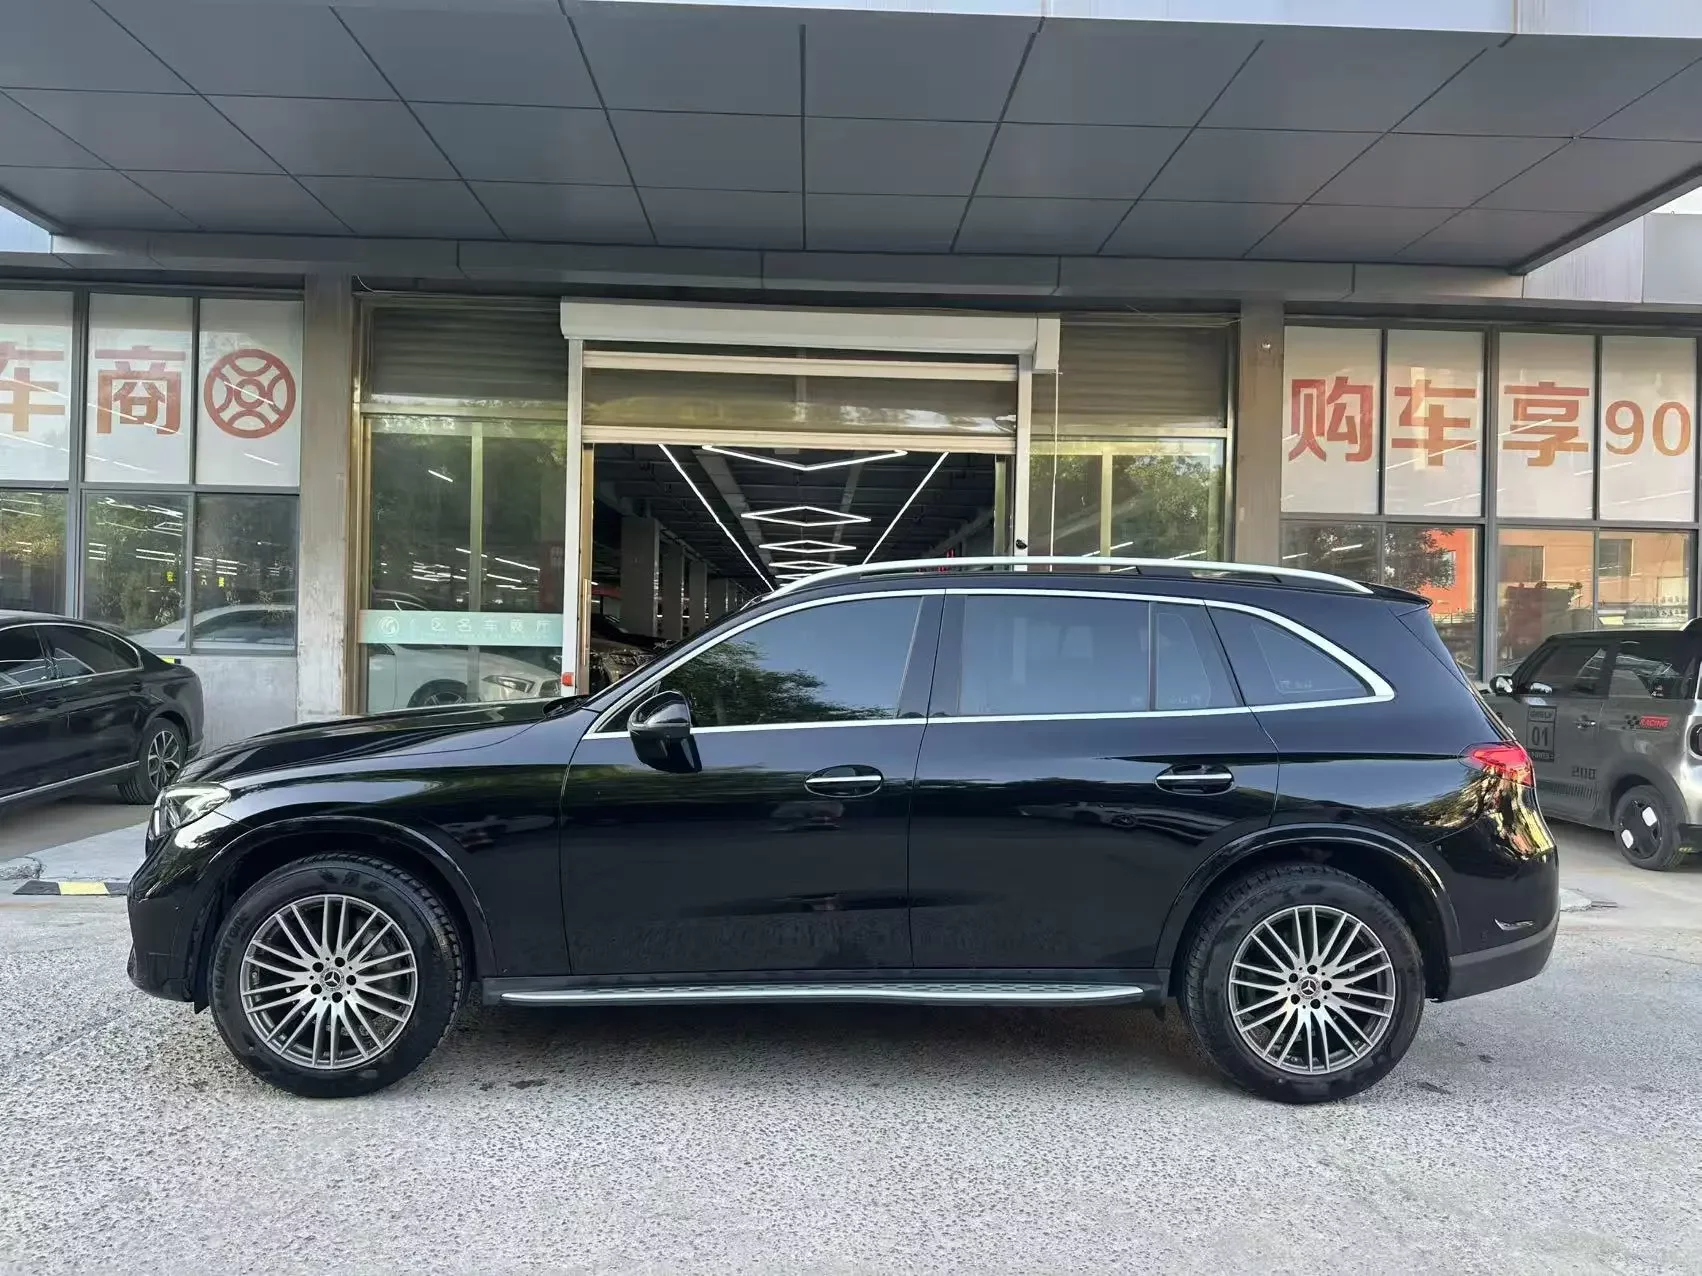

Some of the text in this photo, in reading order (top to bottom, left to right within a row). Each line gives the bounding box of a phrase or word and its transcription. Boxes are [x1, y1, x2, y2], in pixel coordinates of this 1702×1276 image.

[1288, 376, 1692, 468] 购车享90
[1640, 718, 1669, 729] RACING
[1532, 726, 1549, 747] 01
